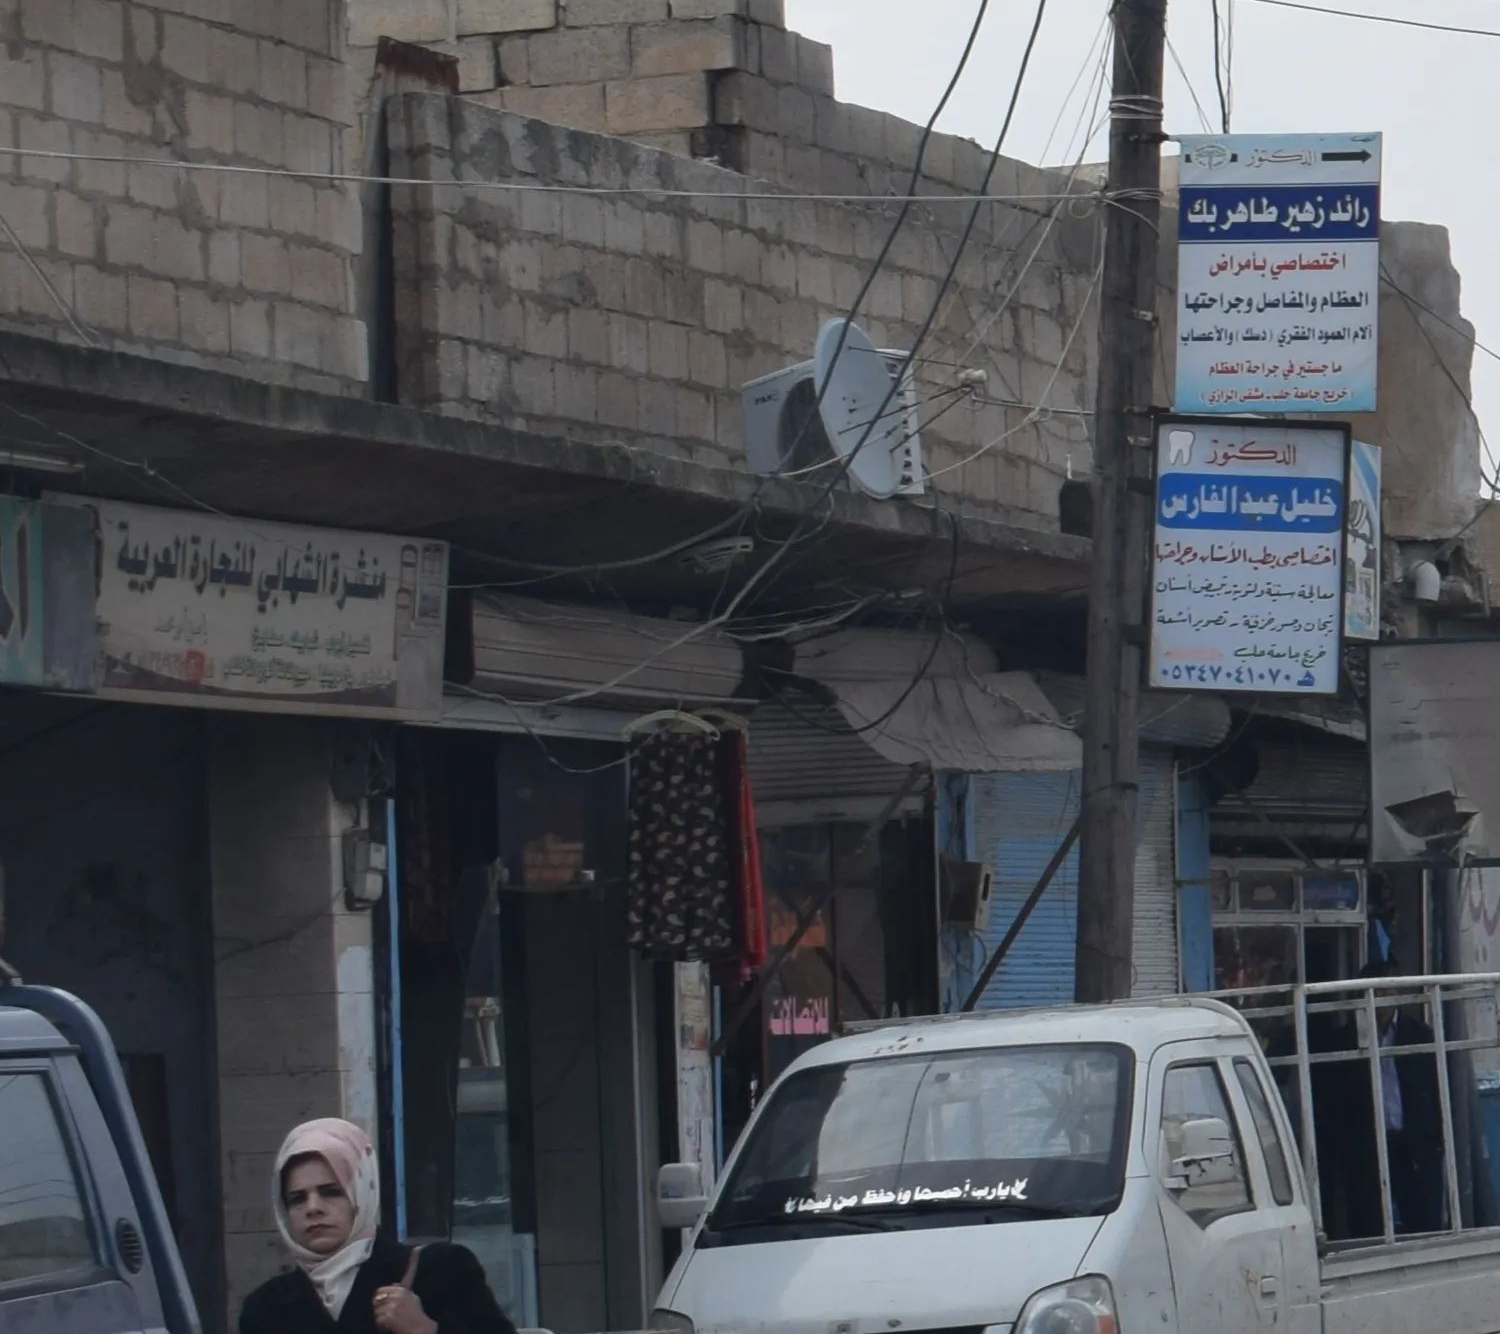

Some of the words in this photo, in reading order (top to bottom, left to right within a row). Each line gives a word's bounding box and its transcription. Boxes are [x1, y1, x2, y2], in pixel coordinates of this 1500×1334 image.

[1187, 197, 1218, 233] بك
[1220, 197, 1278, 230] طاهر
[1281, 195, 1325, 233] زهير
[1329, 194, 1369, 228] رائد
[1209, 252, 1266, 278] بأمراض
[1270, 252, 1346, 280] اختصاصي
[1185, 292, 1253, 314] وجراحتها
[1255, 291, 1316, 314] والمفاصل
[1321, 290, 1369, 314] العظام
[1277, 325, 1316, 347] الفقري
[1318, 326, 1351, 344] العمود
[1209, 360, 1243, 377] العظام
[1282, 359, 1294, 380] في
[1206, 439, 1296, 467] الدكتور
[1161, 484, 1237, 520] الفارس
[1239, 492, 1280, 522] عبد
[1281, 487, 1337, 523] خليل
